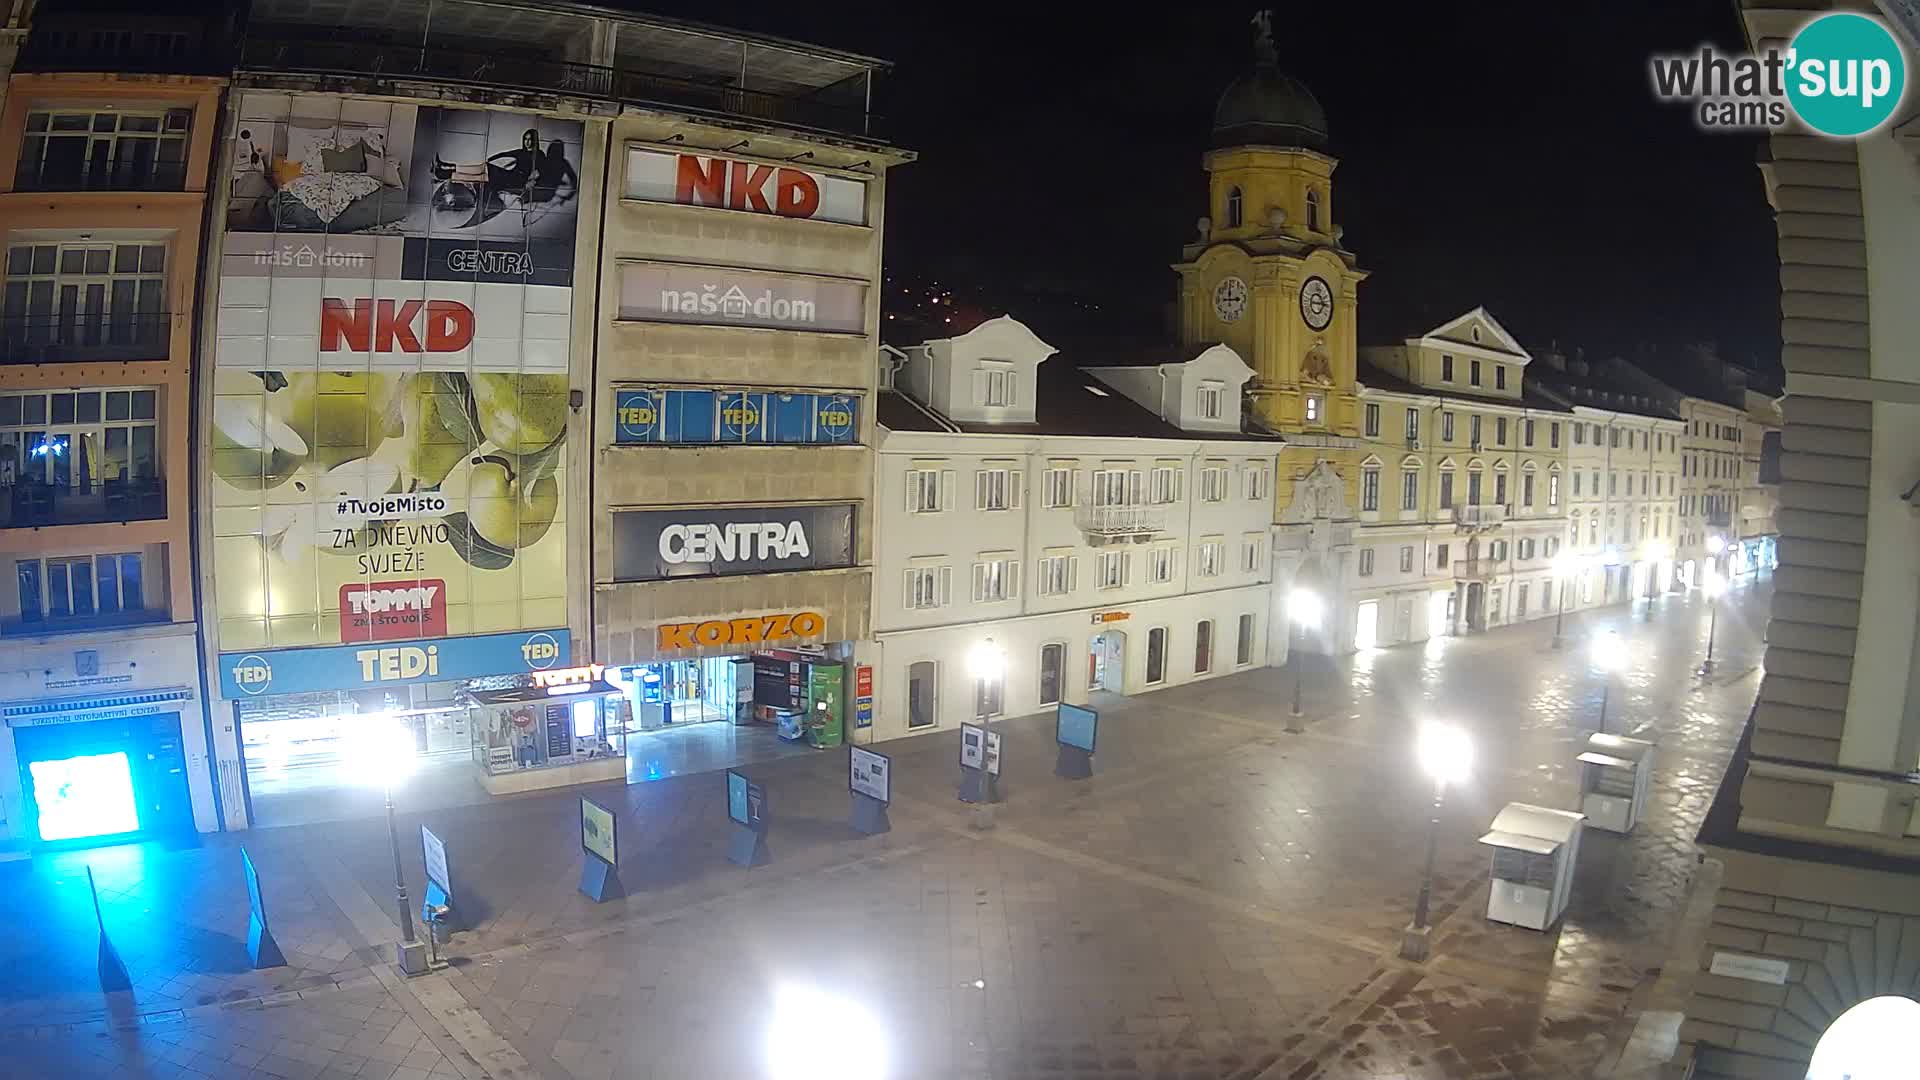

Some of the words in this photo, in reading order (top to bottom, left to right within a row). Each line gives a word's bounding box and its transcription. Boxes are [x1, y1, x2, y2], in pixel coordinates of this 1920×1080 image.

[675, 153, 820, 219] NKD
[317, 247, 365, 269] dom
[447, 250, 534, 275] CENTRA
[660, 283, 718, 316] naš
[753, 289, 816, 323] dom
[319, 297, 476, 353] NKD
[618, 407, 657, 425] TEDi
[723, 408, 760, 425] TEDi
[819, 411, 852, 427] TEDi
[336, 496, 446, 517] #TvojeMisto
[332, 528, 357, 549] ZA
[365, 523, 450, 548] DNEVNO
[658, 520, 810, 564] CENTRA
[358, 548, 426, 575] SVJEŽE
[347, 586, 439, 614] TOMMY
[658, 612, 825, 649] KORZO
[521, 641, 559, 660] TEDi
[232, 664, 273, 682] TEDi
[355, 645, 439, 683] TEDi
